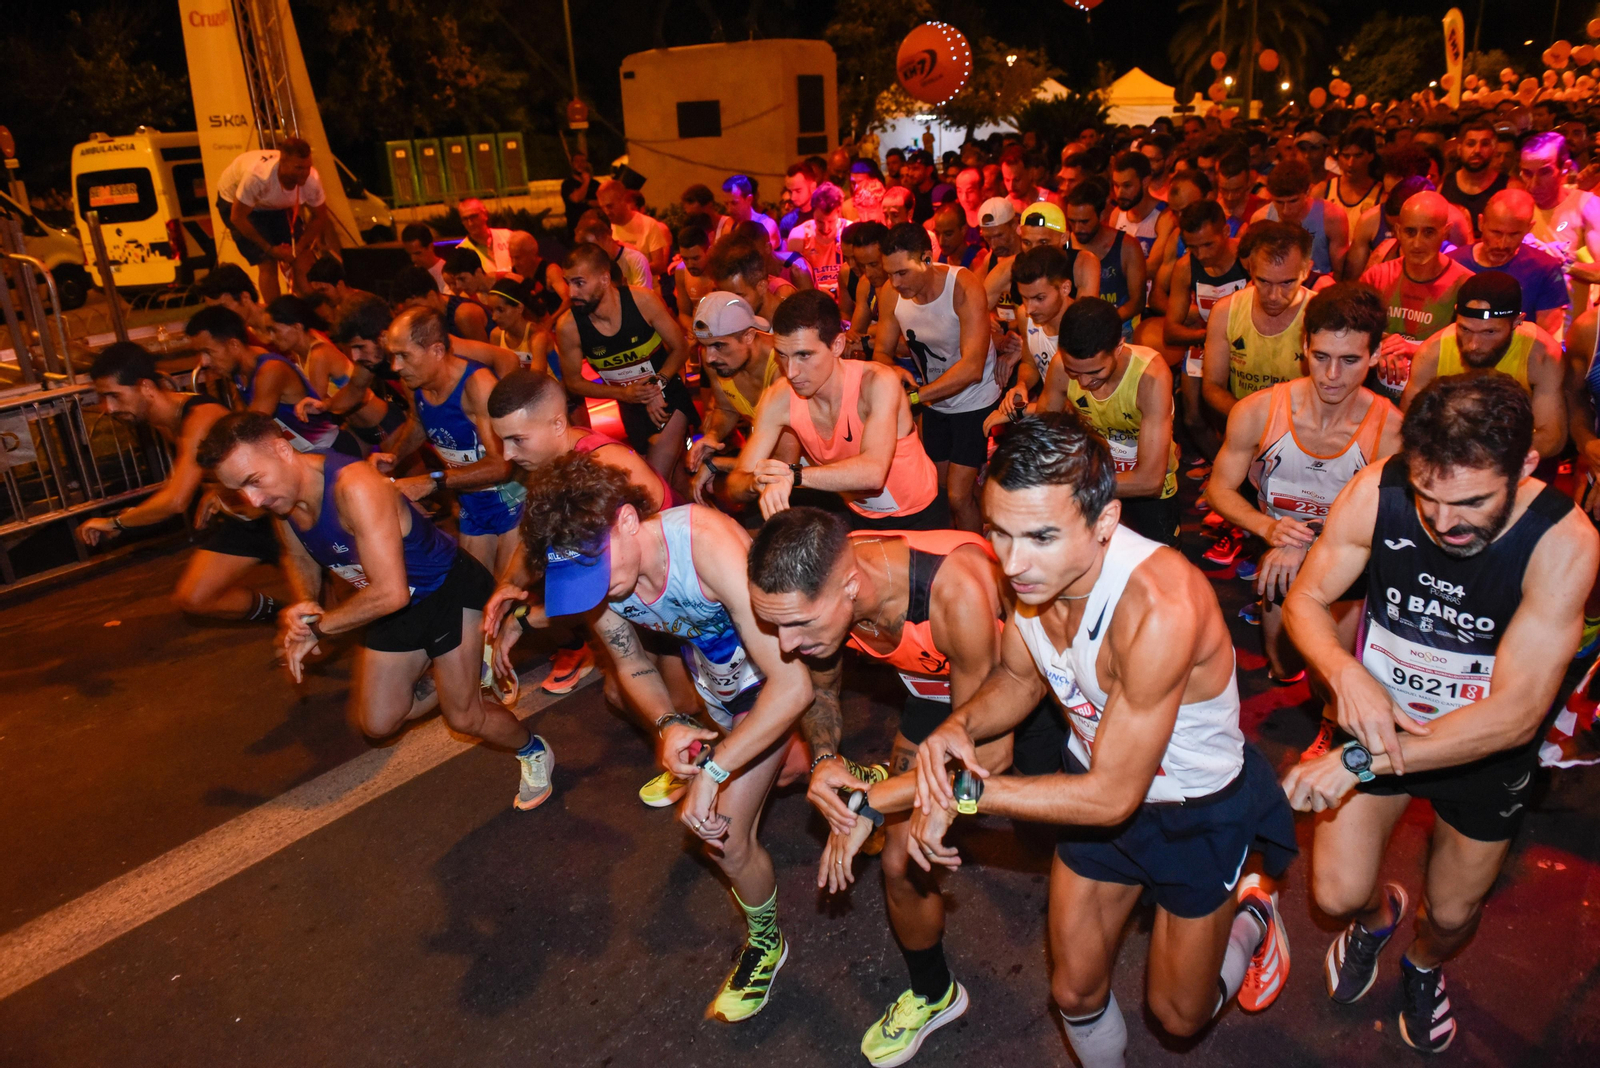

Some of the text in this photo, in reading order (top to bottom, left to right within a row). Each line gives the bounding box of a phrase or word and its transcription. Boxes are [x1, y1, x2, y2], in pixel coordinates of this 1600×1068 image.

[80, 143, 136, 156] AMBULANCIA
[1386, 305, 1434, 325] ANTONIO
[603, 350, 639, 368] ASM
[1418, 572, 1466, 598] CUPA
[1386, 587, 1402, 605] O
[1407, 595, 1496, 632] BARCO
[1392, 667, 1458, 699] 9621
